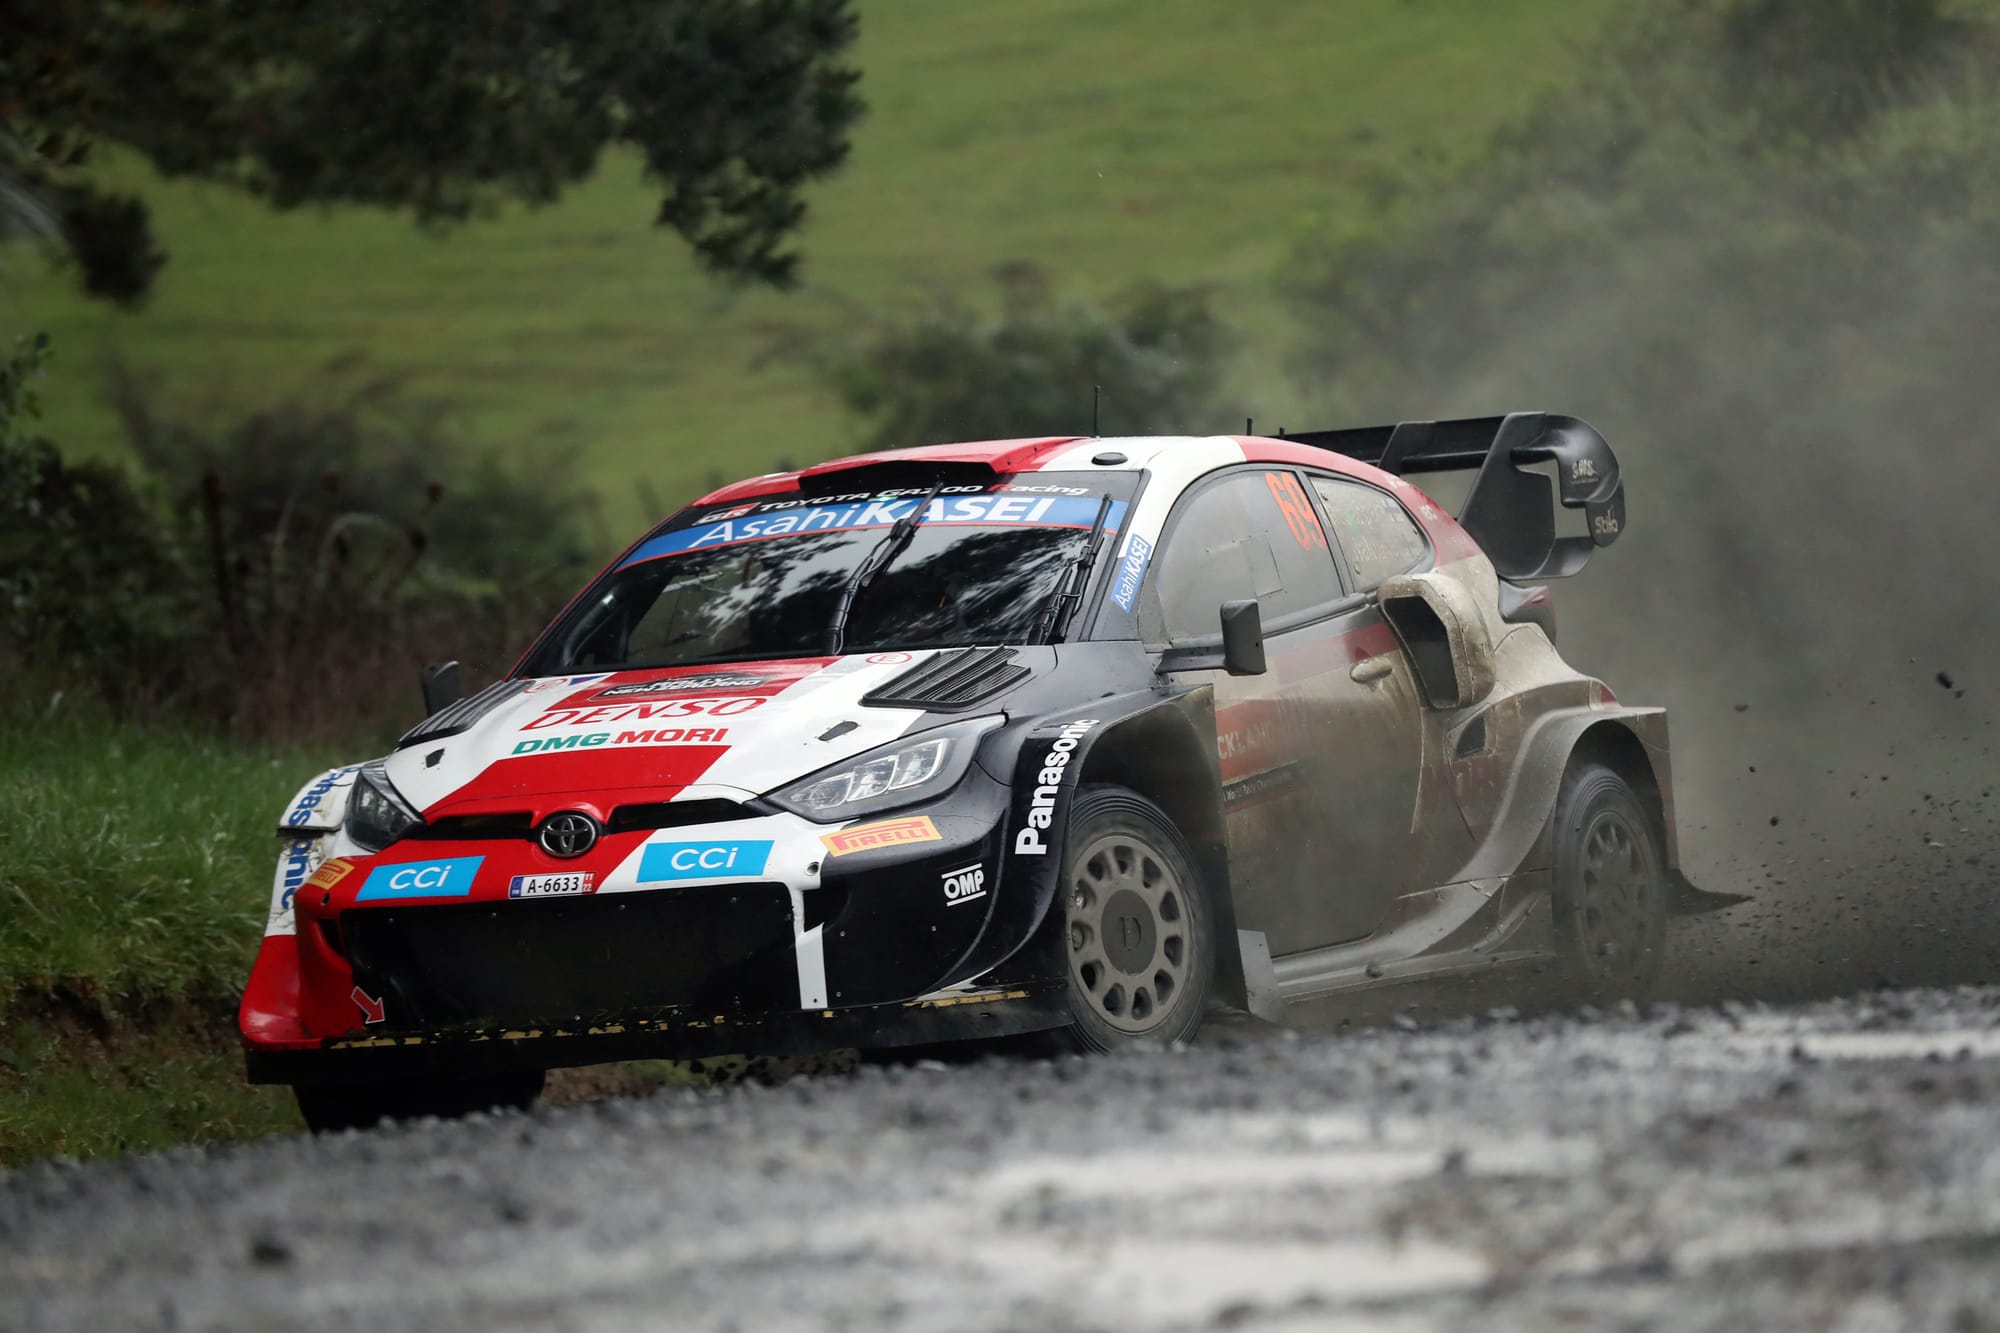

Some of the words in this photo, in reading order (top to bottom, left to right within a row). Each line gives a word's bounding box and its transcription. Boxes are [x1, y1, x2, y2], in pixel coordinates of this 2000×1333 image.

[760, 491, 871, 512] TOYOTA
[988, 483, 1089, 496] Racing
[1264, 471, 1327, 551] 69
[518, 697, 768, 731] DENSO
[511, 732, 610, 755] DMG
[612, 728, 729, 744] MORI
[1015, 718, 1100, 855] Panasonic
[830, 820, 930, 852] PIRELLI
[527, 876, 580, 894] A-6633
[943, 869, 985, 899] OMP
